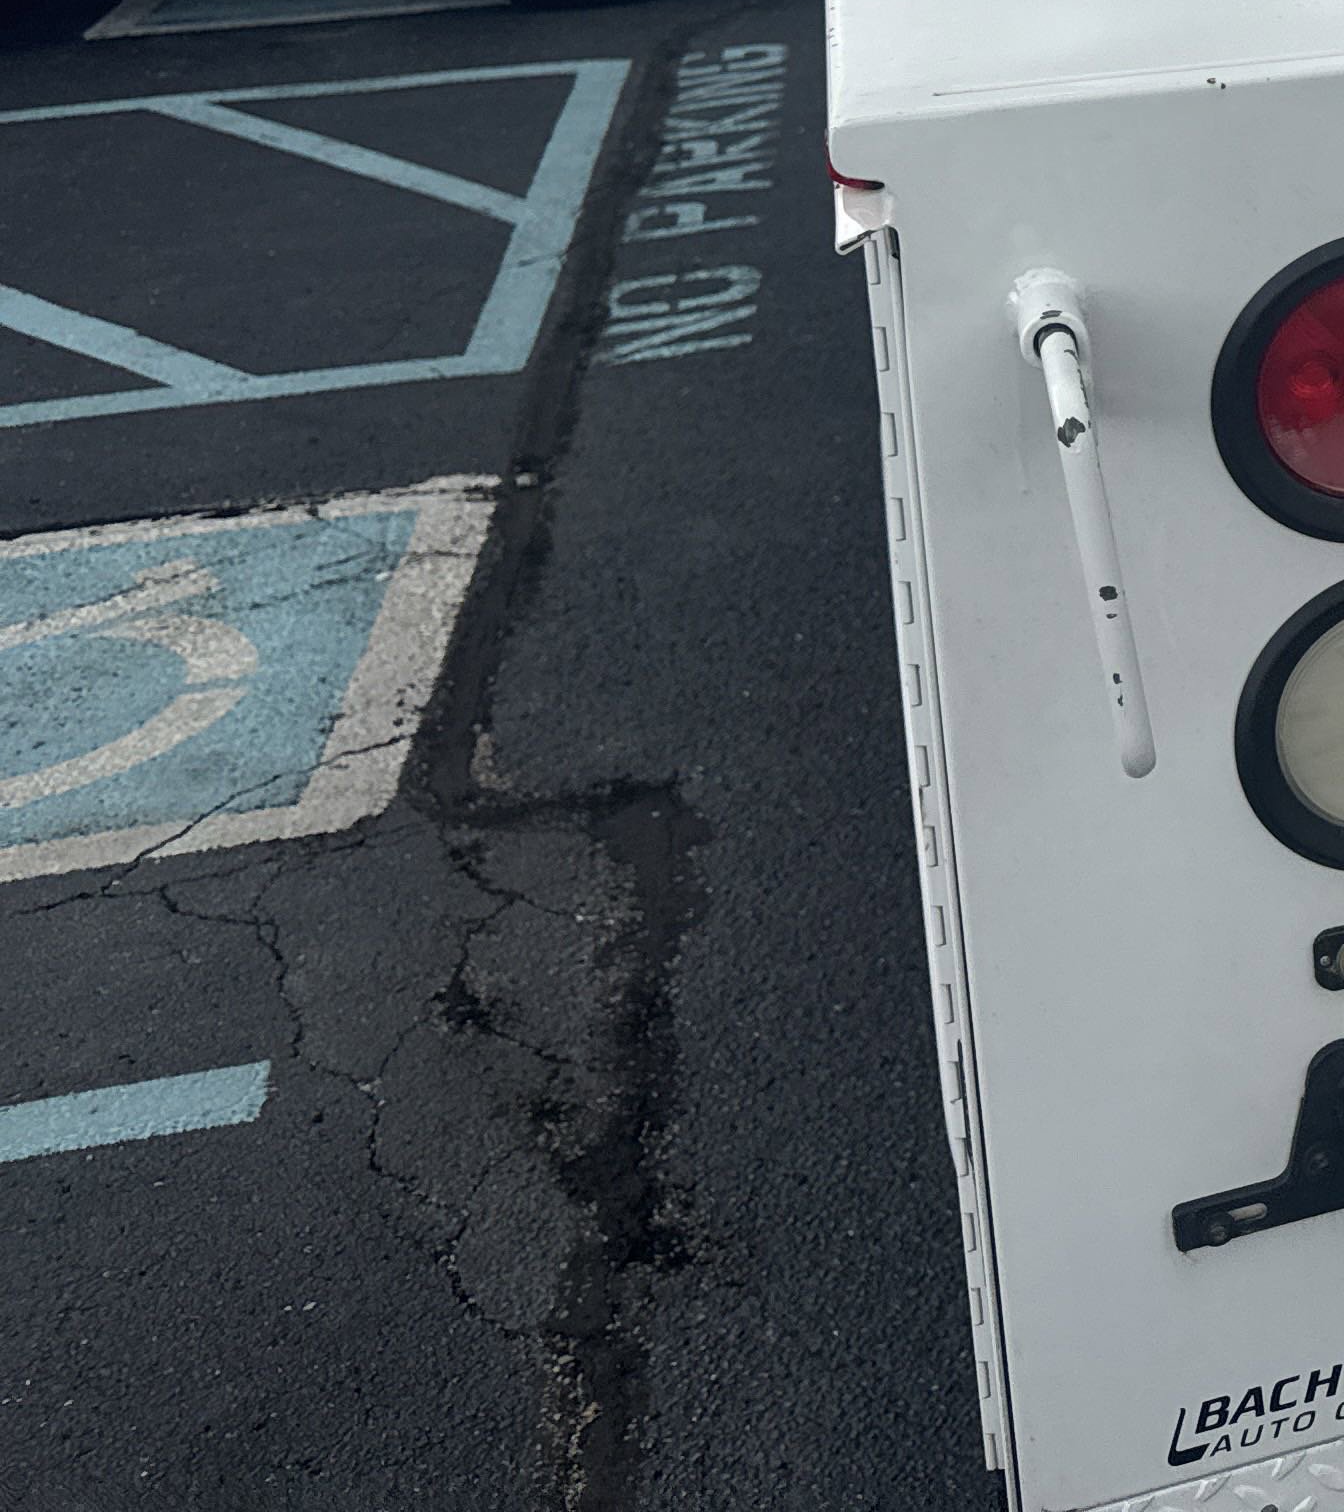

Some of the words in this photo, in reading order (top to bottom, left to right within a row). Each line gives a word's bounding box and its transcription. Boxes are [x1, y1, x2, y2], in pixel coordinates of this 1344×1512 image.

[622, 43, 788, 243] PARKING
[592, 265, 762, 367] NO
[1209, 1410, 1316, 1457] AUTO
